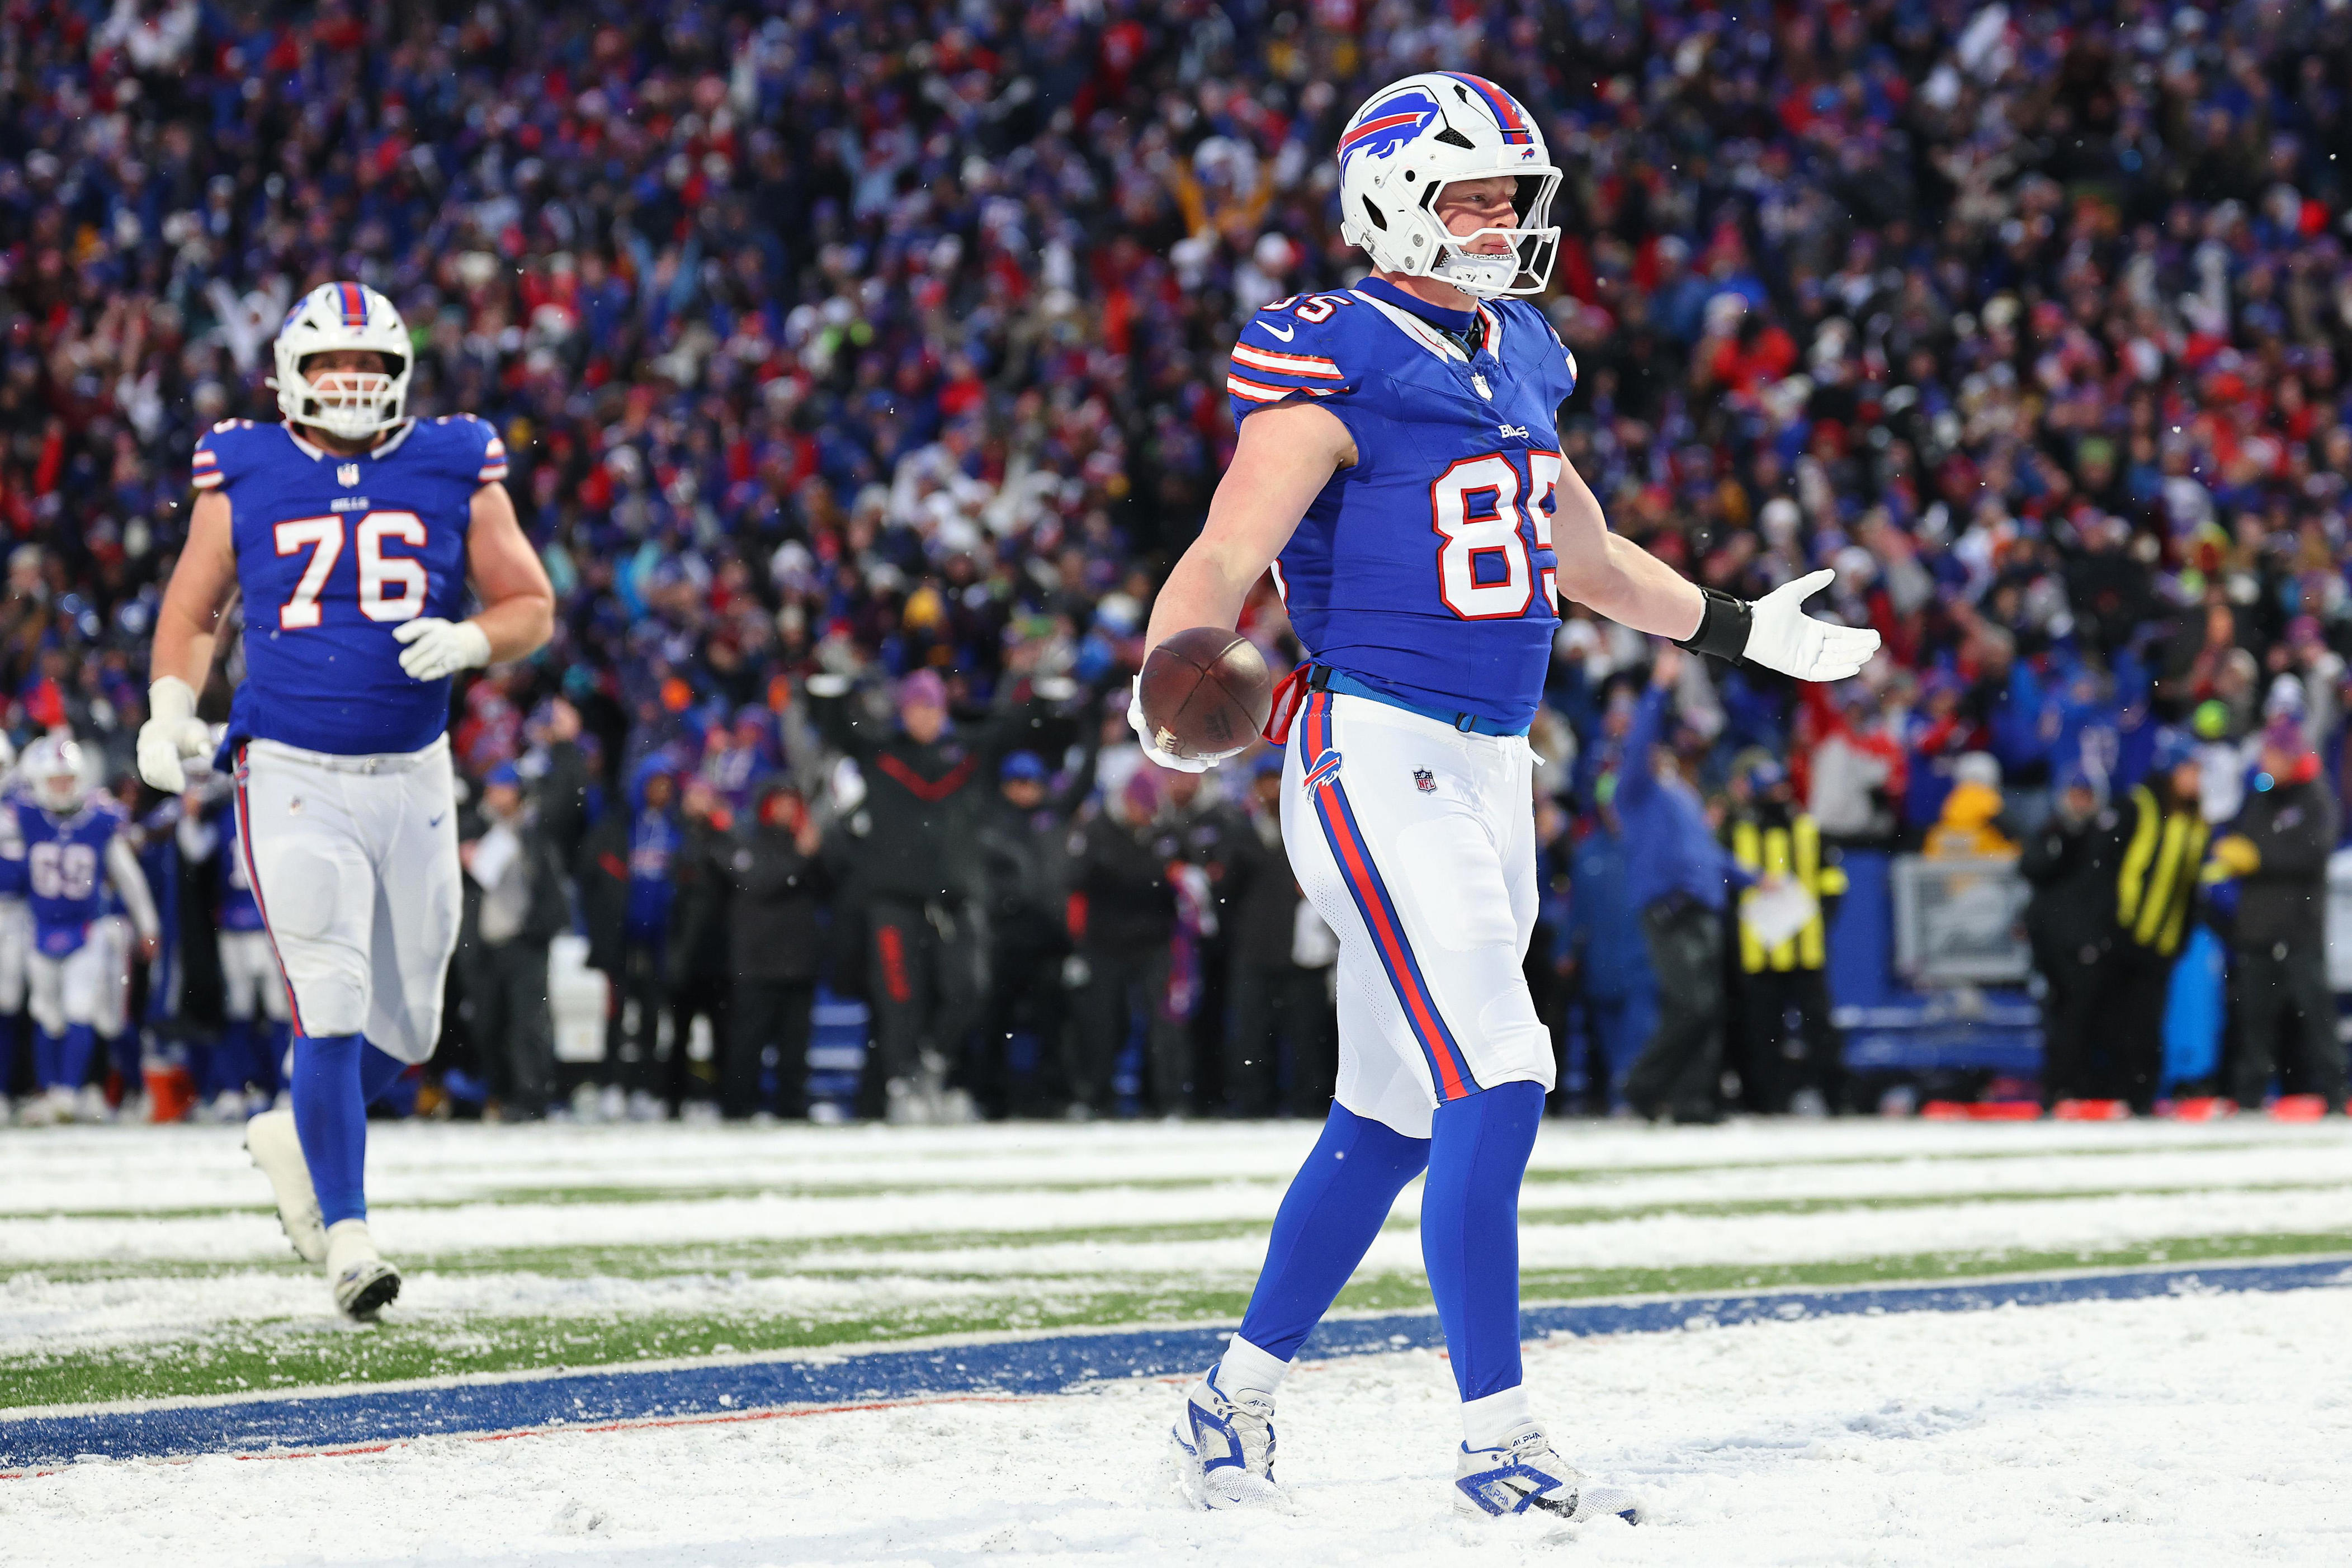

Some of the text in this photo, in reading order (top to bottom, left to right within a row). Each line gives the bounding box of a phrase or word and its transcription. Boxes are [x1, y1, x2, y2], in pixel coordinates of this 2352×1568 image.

[273, 509, 427, 629] 76
[1418, 779, 1434, 789] NFL
[1513, 1432, 1542, 1447] ALPHA
[1482, 1484, 1509, 1506] ALPHA
